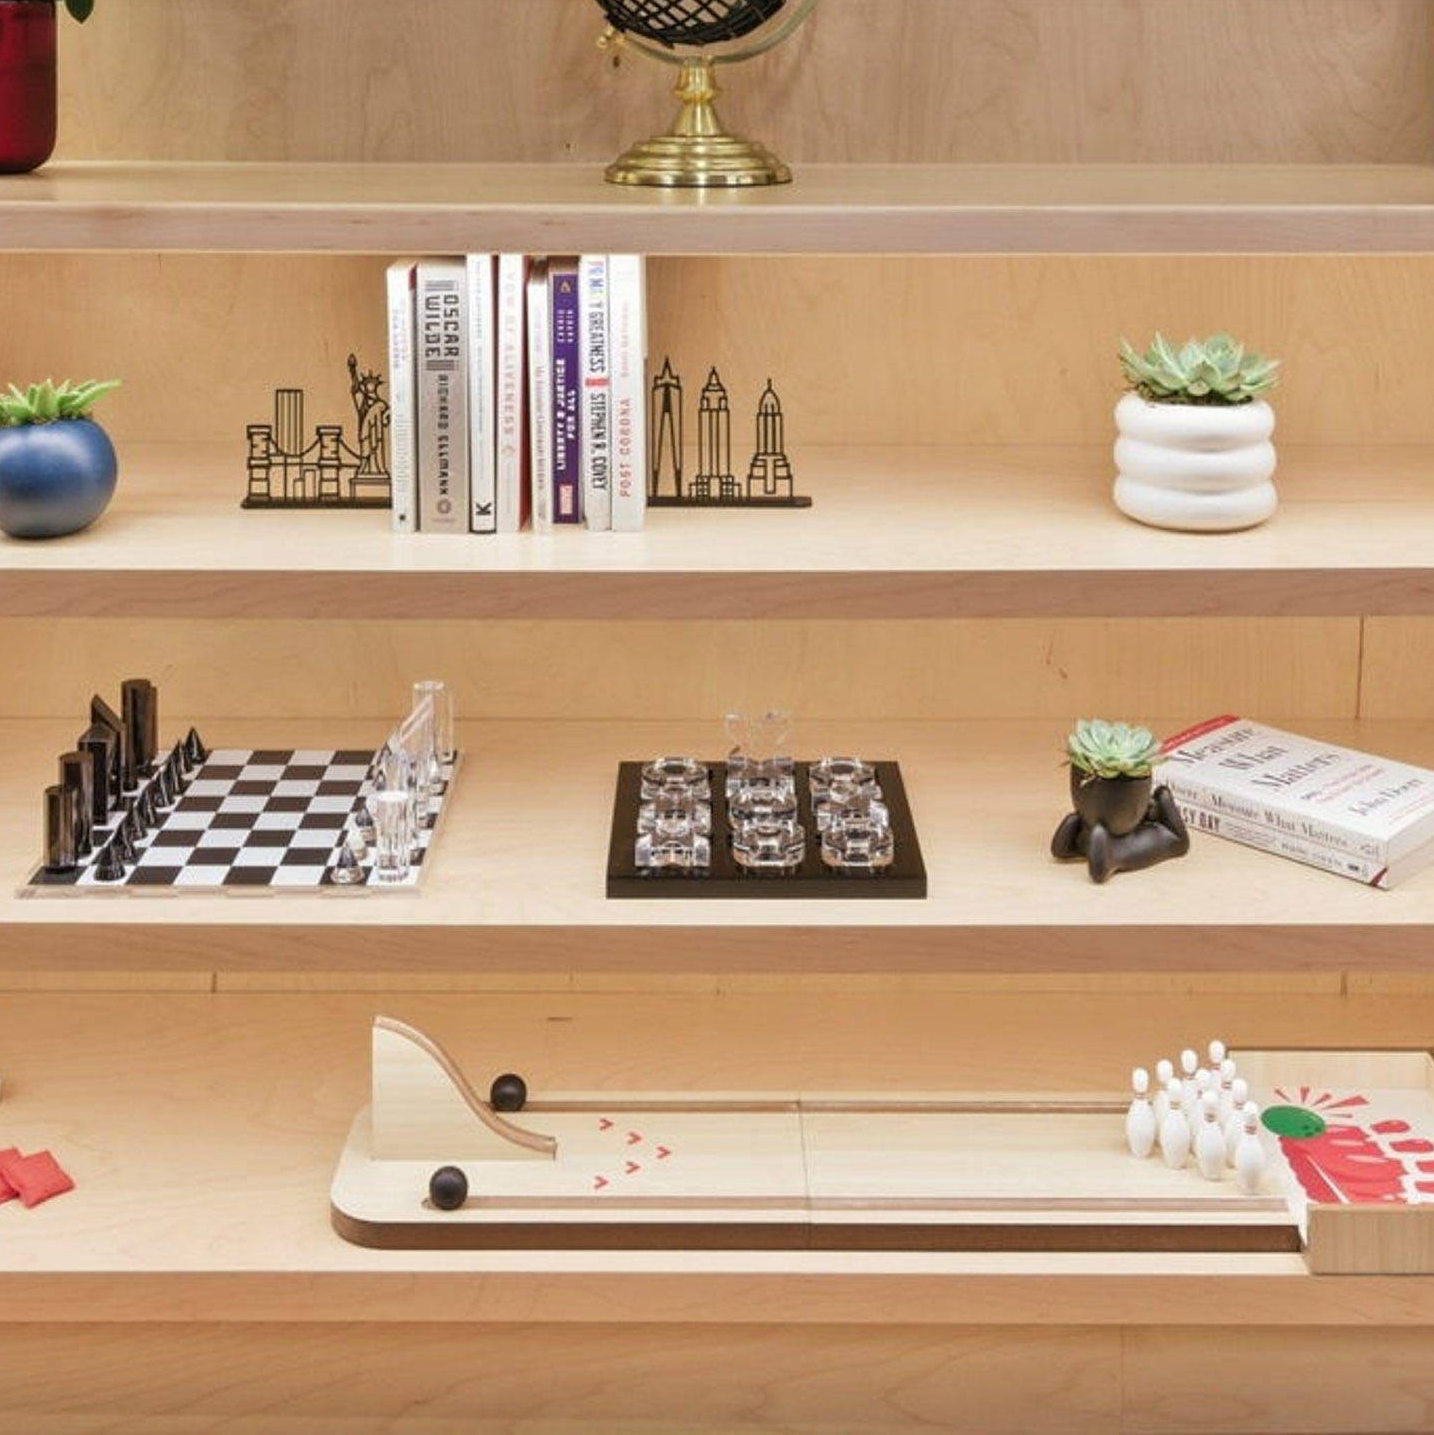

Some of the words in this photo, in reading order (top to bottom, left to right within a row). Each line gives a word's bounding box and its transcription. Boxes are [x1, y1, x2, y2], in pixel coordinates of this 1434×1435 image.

[425, 296, 441, 358] WILDE
[443, 294, 459, 357] OSCAR
[589, 312, 605, 373] GREATNESS
[437, 374, 449, 430] RICHARD
[591, 392, 606, 440] STEPHEN
[620, 398, 631, 456] CORONA
[592, 456, 608, 491] COVEY
[620, 463, 631, 498] POST
[1169, 728, 1254, 766] Measure
[1218, 745, 1288, 772] What
[1251, 753, 1341, 791] Matters
[1199, 812, 1221, 833] DAY
[1264, 809, 1296, 832] What
